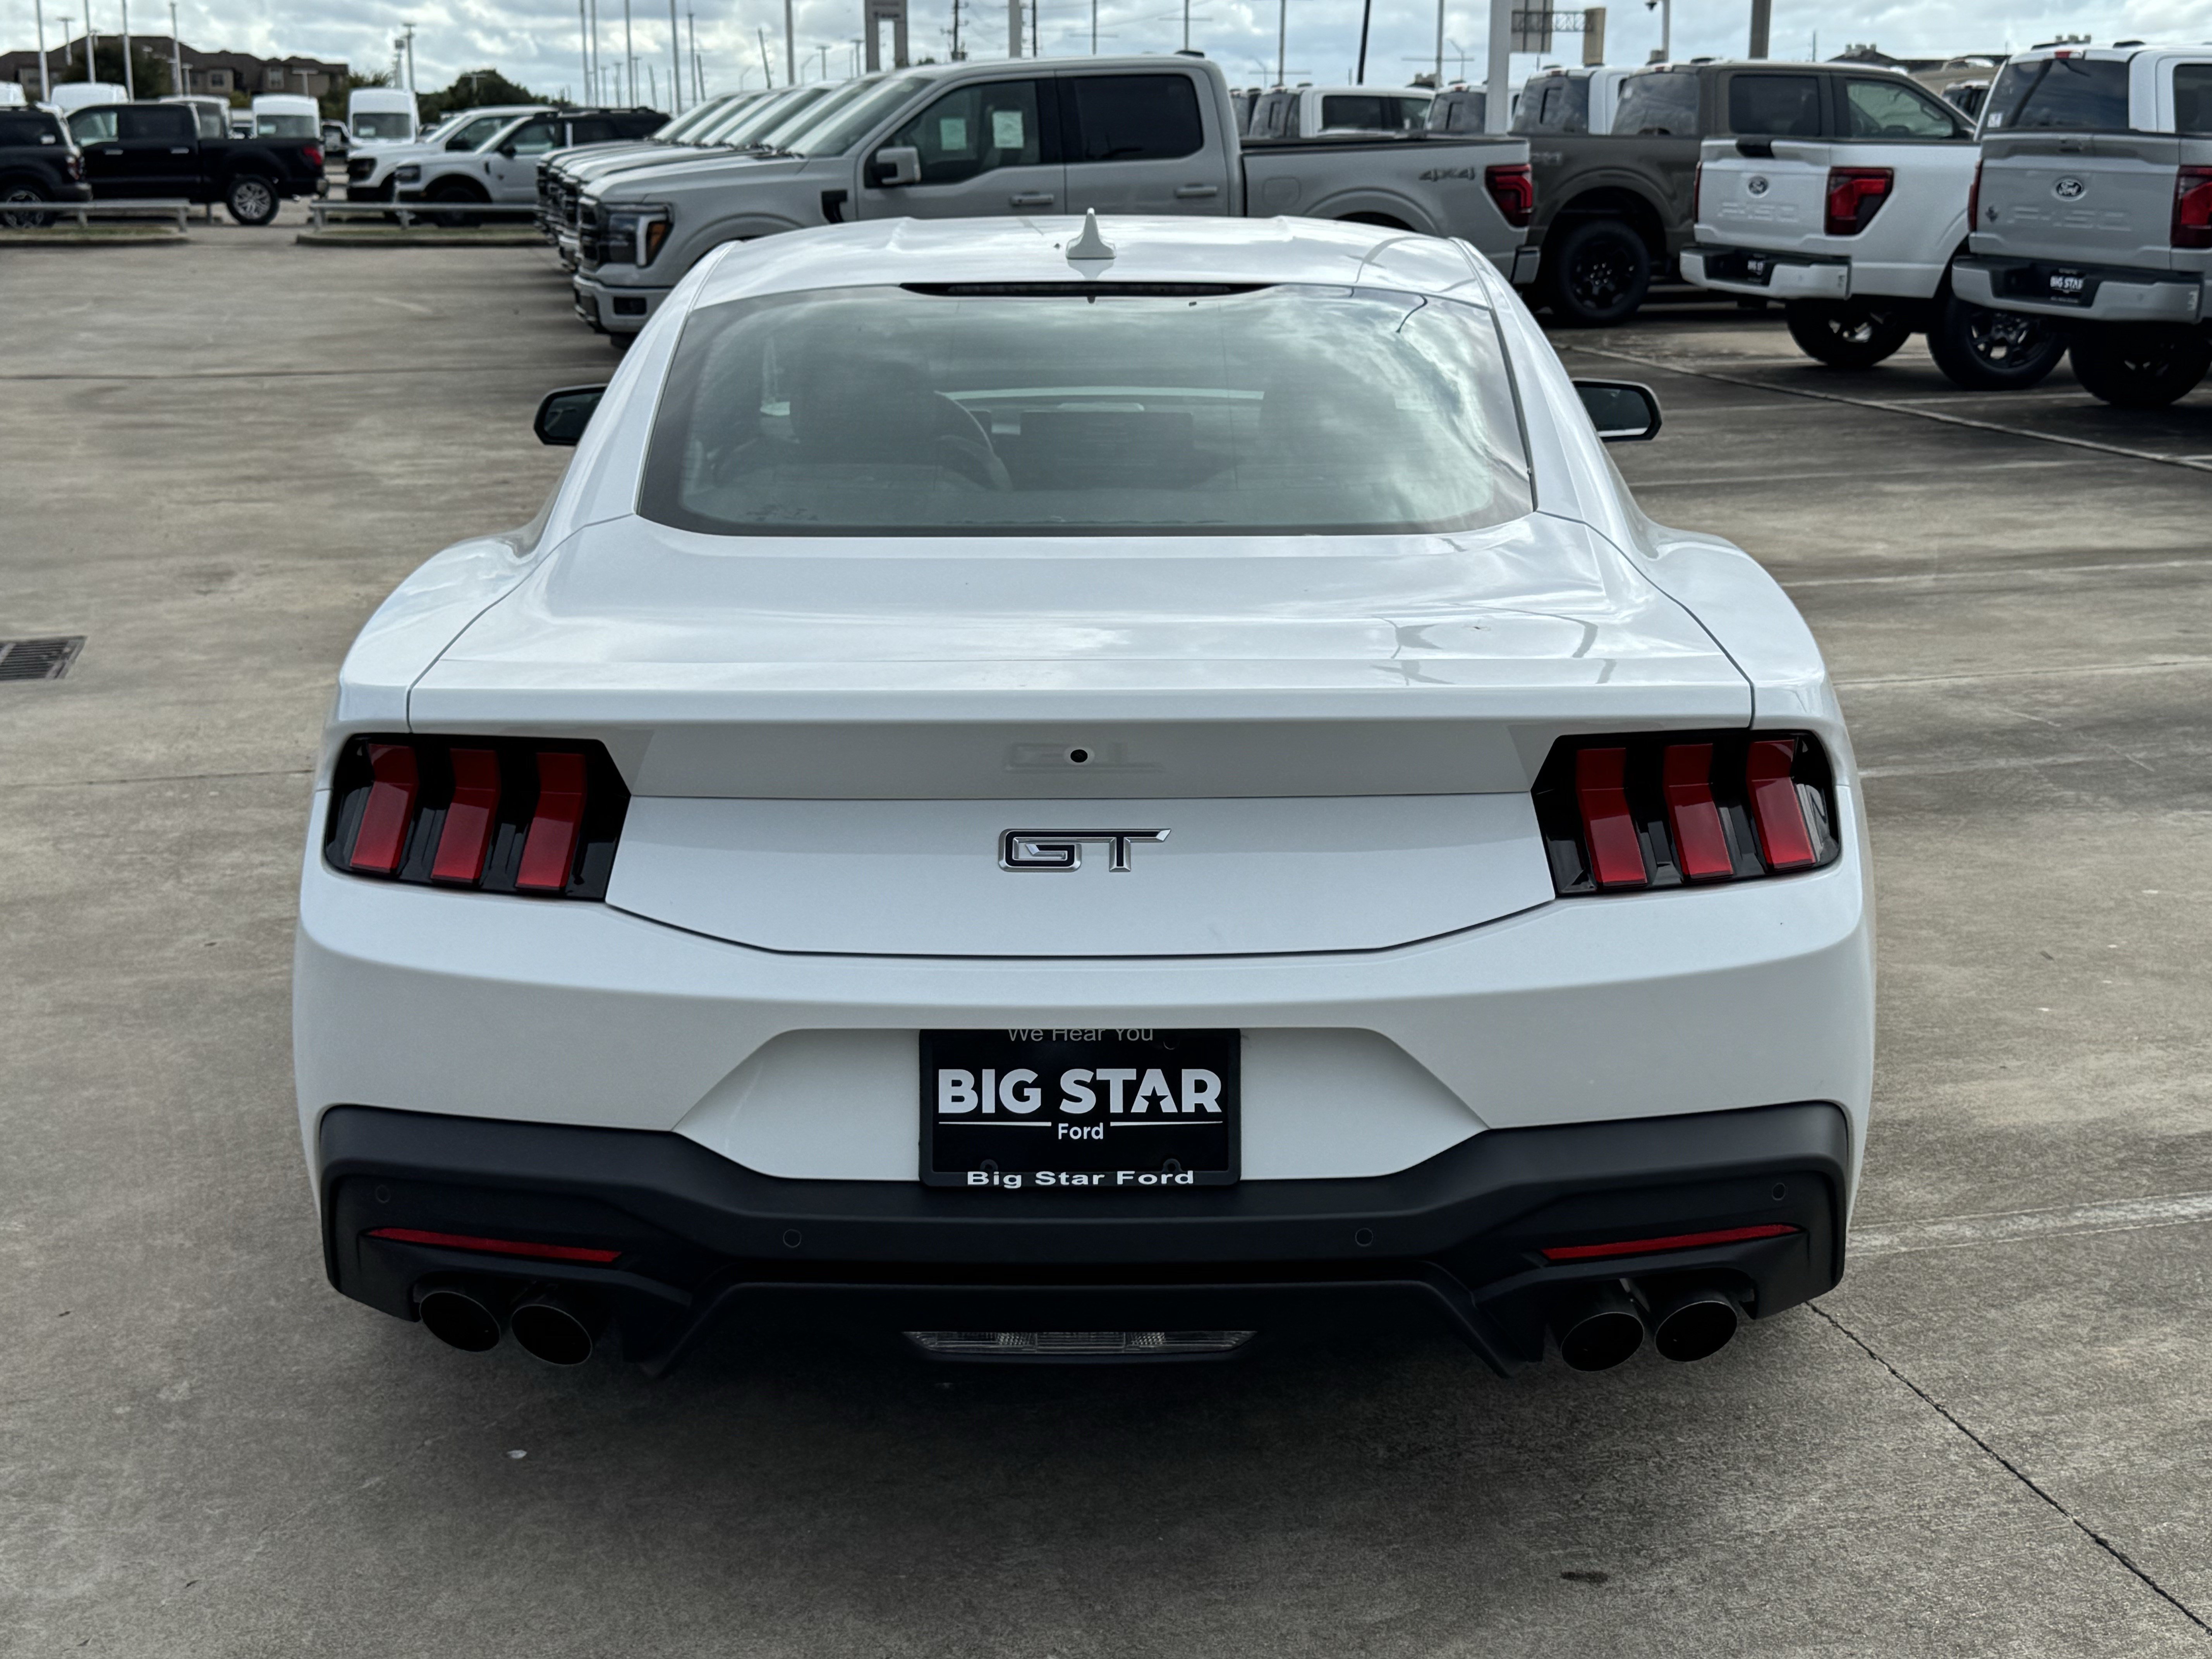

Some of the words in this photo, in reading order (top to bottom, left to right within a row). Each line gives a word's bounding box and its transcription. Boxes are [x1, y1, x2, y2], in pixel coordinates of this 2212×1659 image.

[998, 828, 1171, 872] GT
[1008, 1029, 1043, 1041] We
[1053, 1029, 1106, 1041] Hear
[1115, 1029, 1153, 1041] You
[938, 1068, 1042, 1114] BIG
[1059, 1068, 1222, 1114] STAR
[1058, 1122, 1104, 1140] Ford
[967, 1171, 1022, 1189] Big
[1035, 1171, 1105, 1186] Star
[1116, 1170, 1194, 1185] Ford
